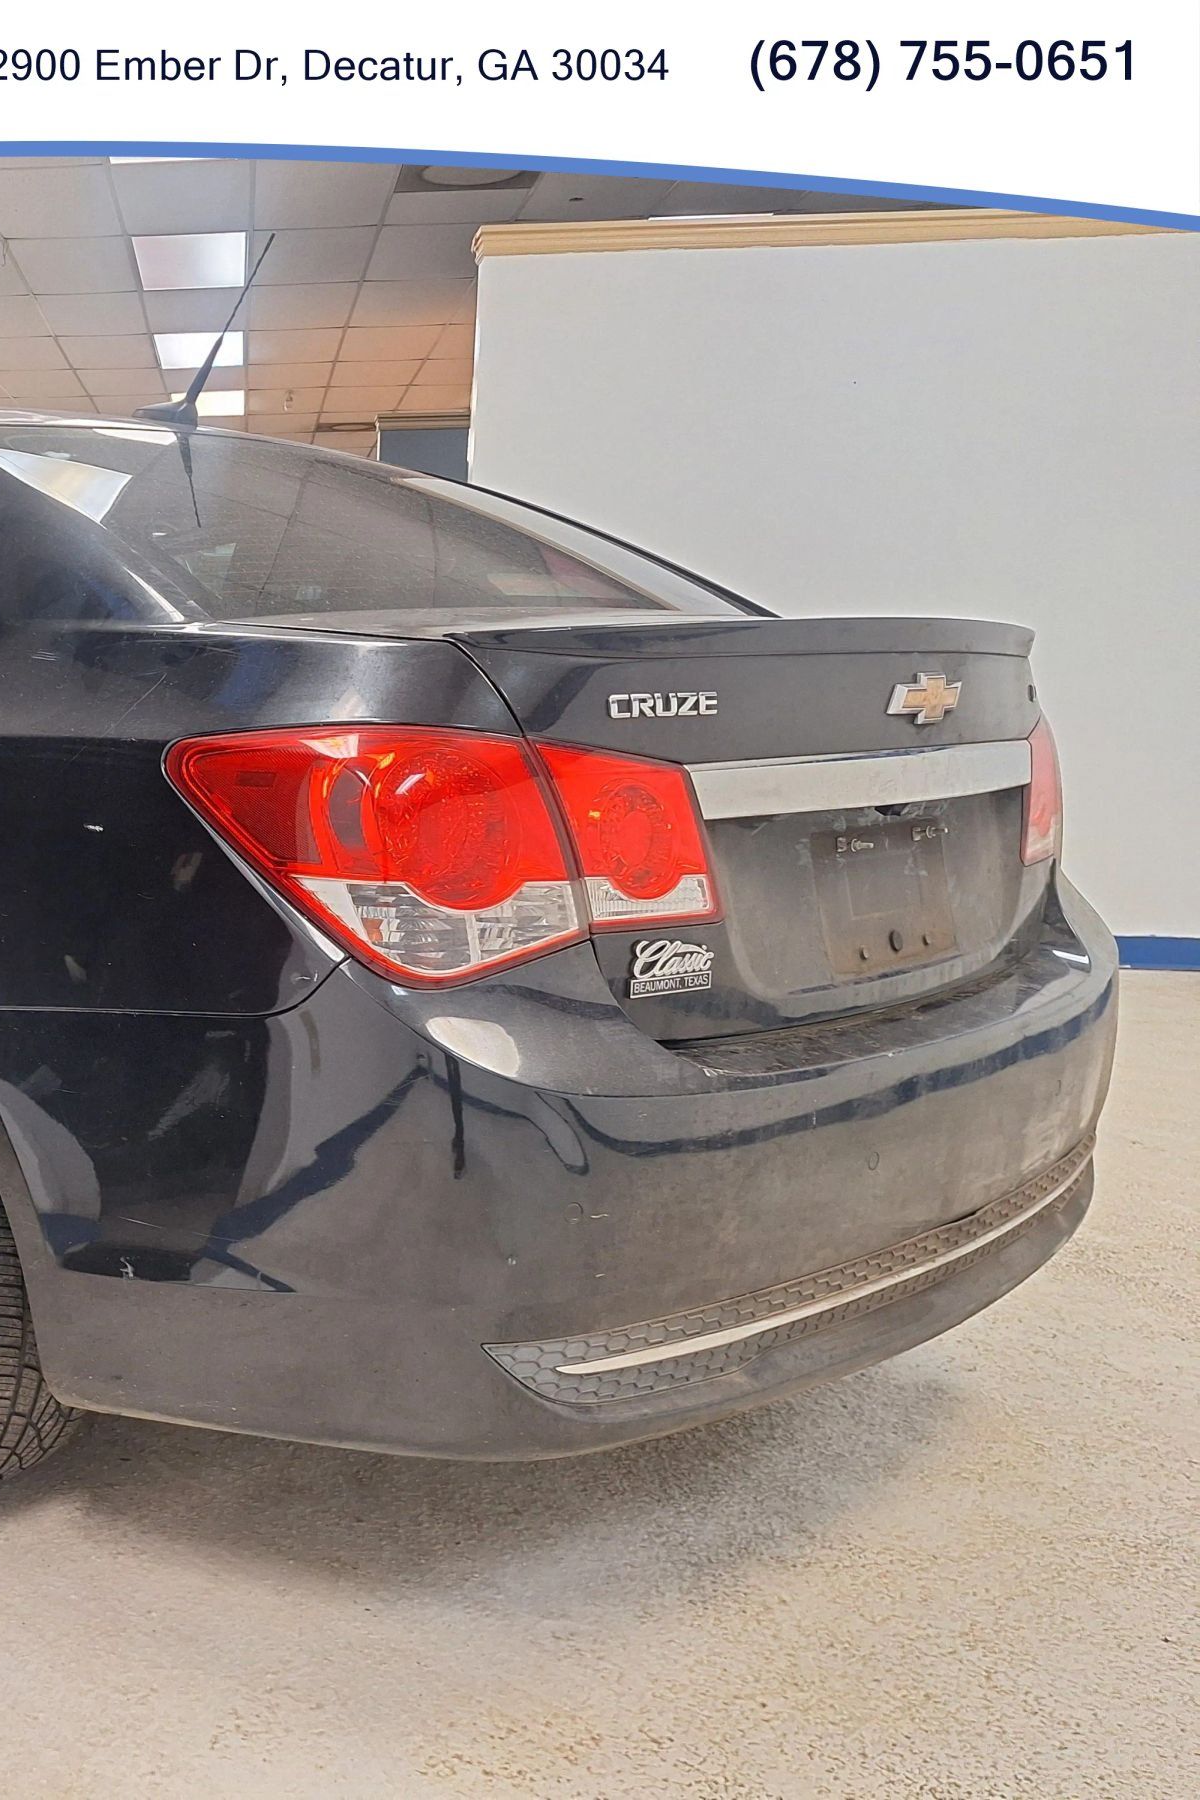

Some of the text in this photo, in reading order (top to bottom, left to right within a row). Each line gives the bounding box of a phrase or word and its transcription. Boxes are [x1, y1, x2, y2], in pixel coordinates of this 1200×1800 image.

[608, 691, 718, 719] CRUZE
[633, 940, 715, 978] Classic
[684, 974, 708, 987] TEXAS
